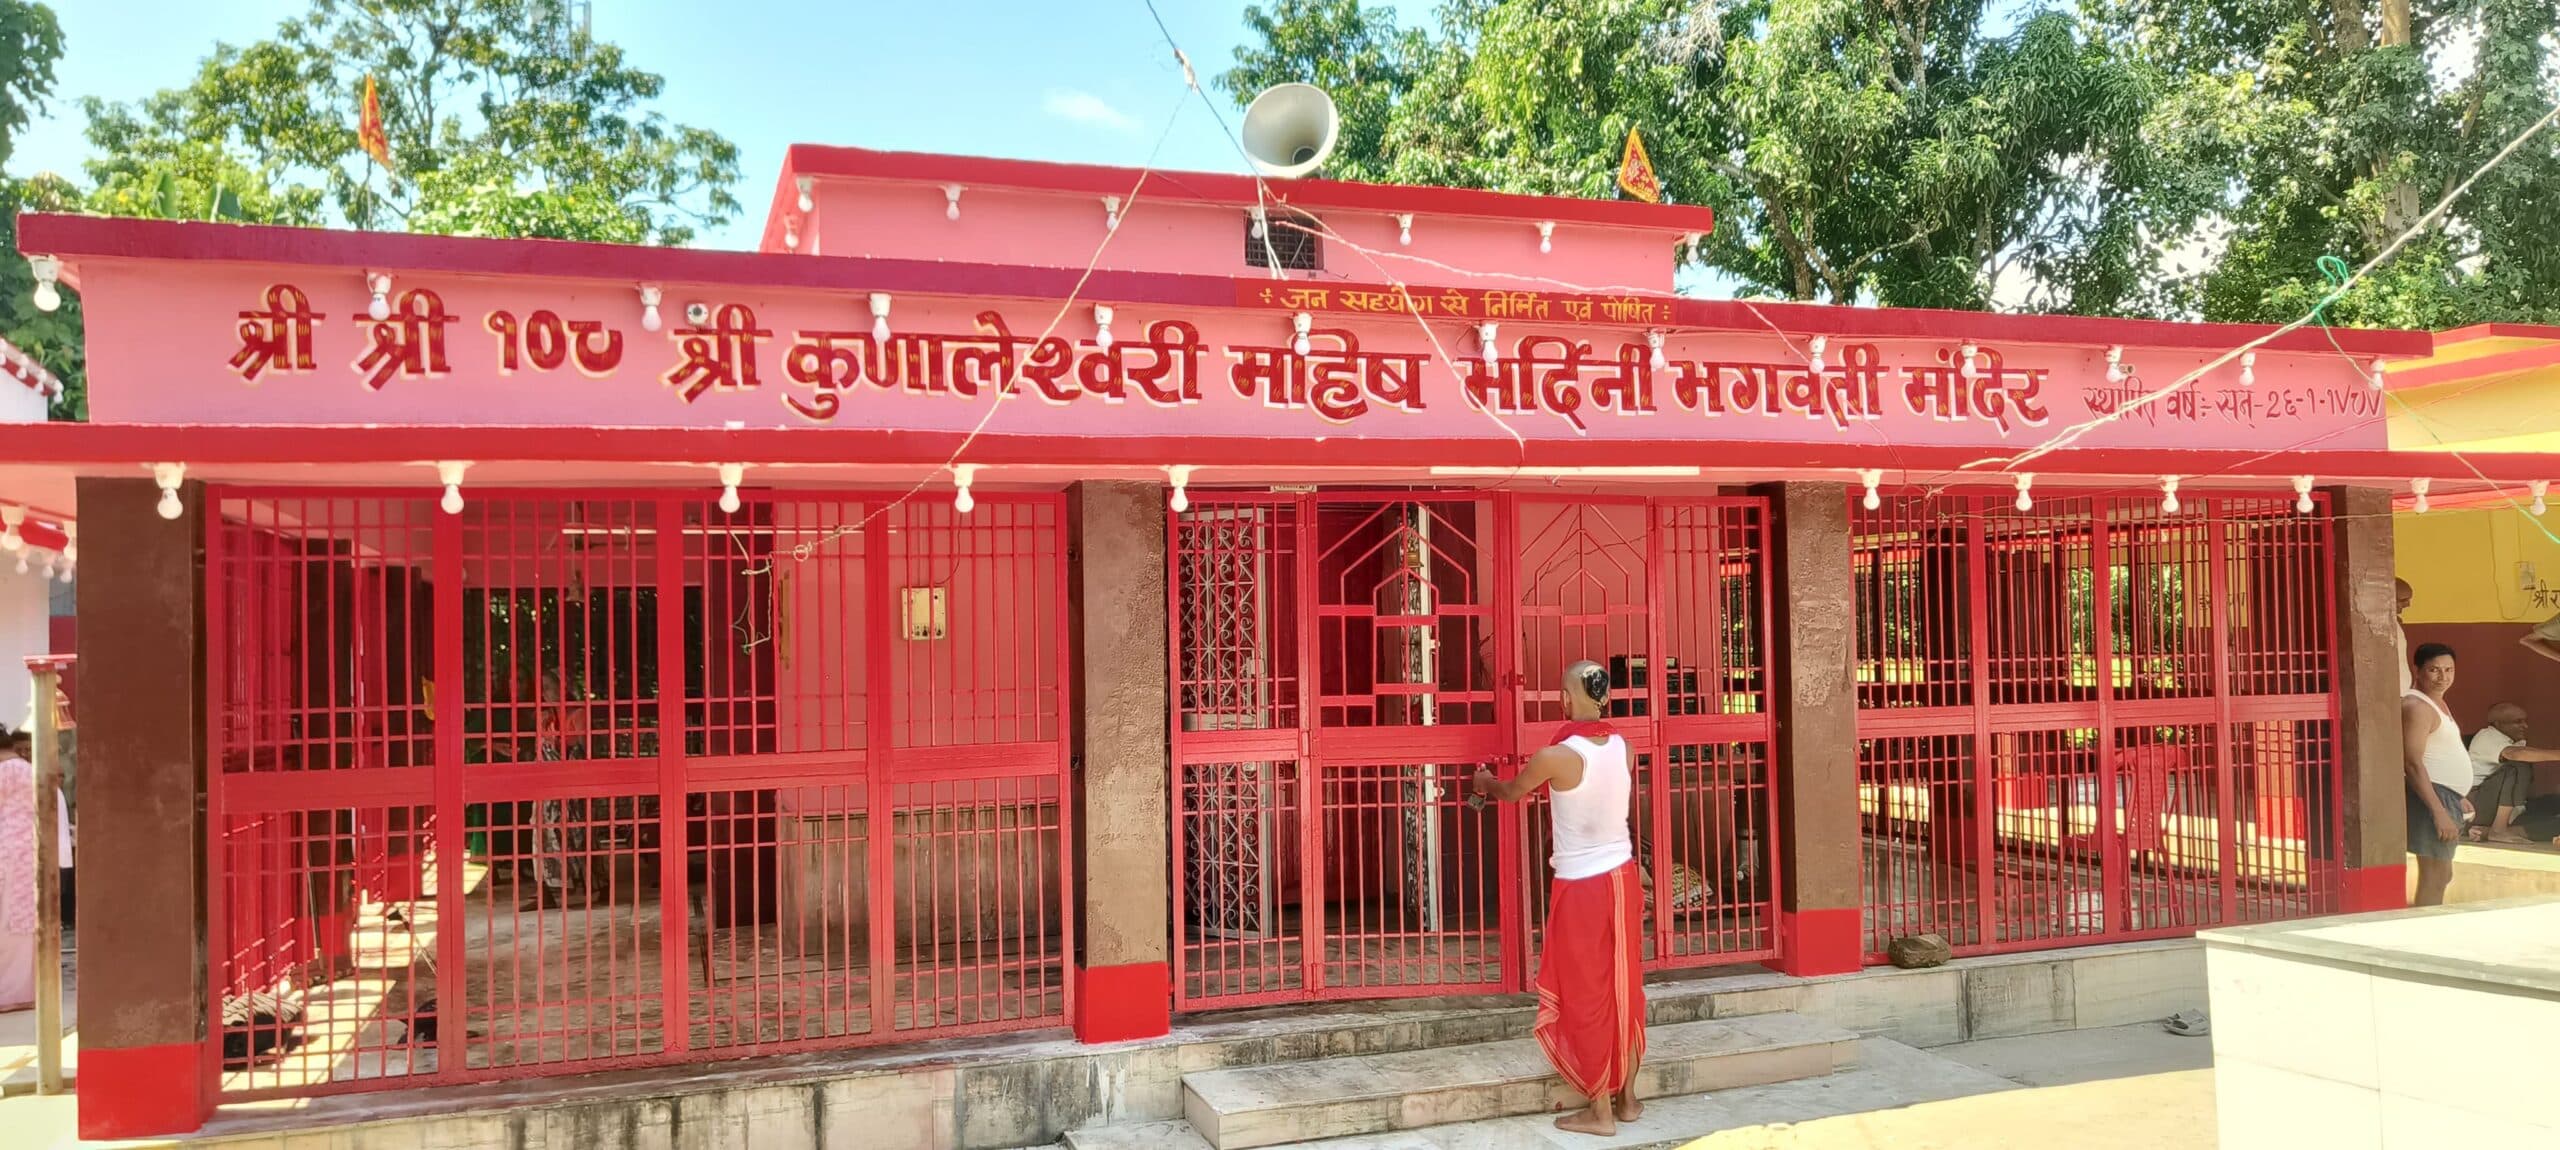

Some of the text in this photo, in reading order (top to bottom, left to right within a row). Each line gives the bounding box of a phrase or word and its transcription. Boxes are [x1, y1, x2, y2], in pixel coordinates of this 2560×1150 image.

[1280, 286, 1656, 323] जन सहयोग से निर्मित एवं पोषित
[228, 284, 326, 381] श्री
[351, 287, 460, 391] श्री
[661, 303, 774, 404] श्री
[1898, 346, 2050, 437] मंदिर
